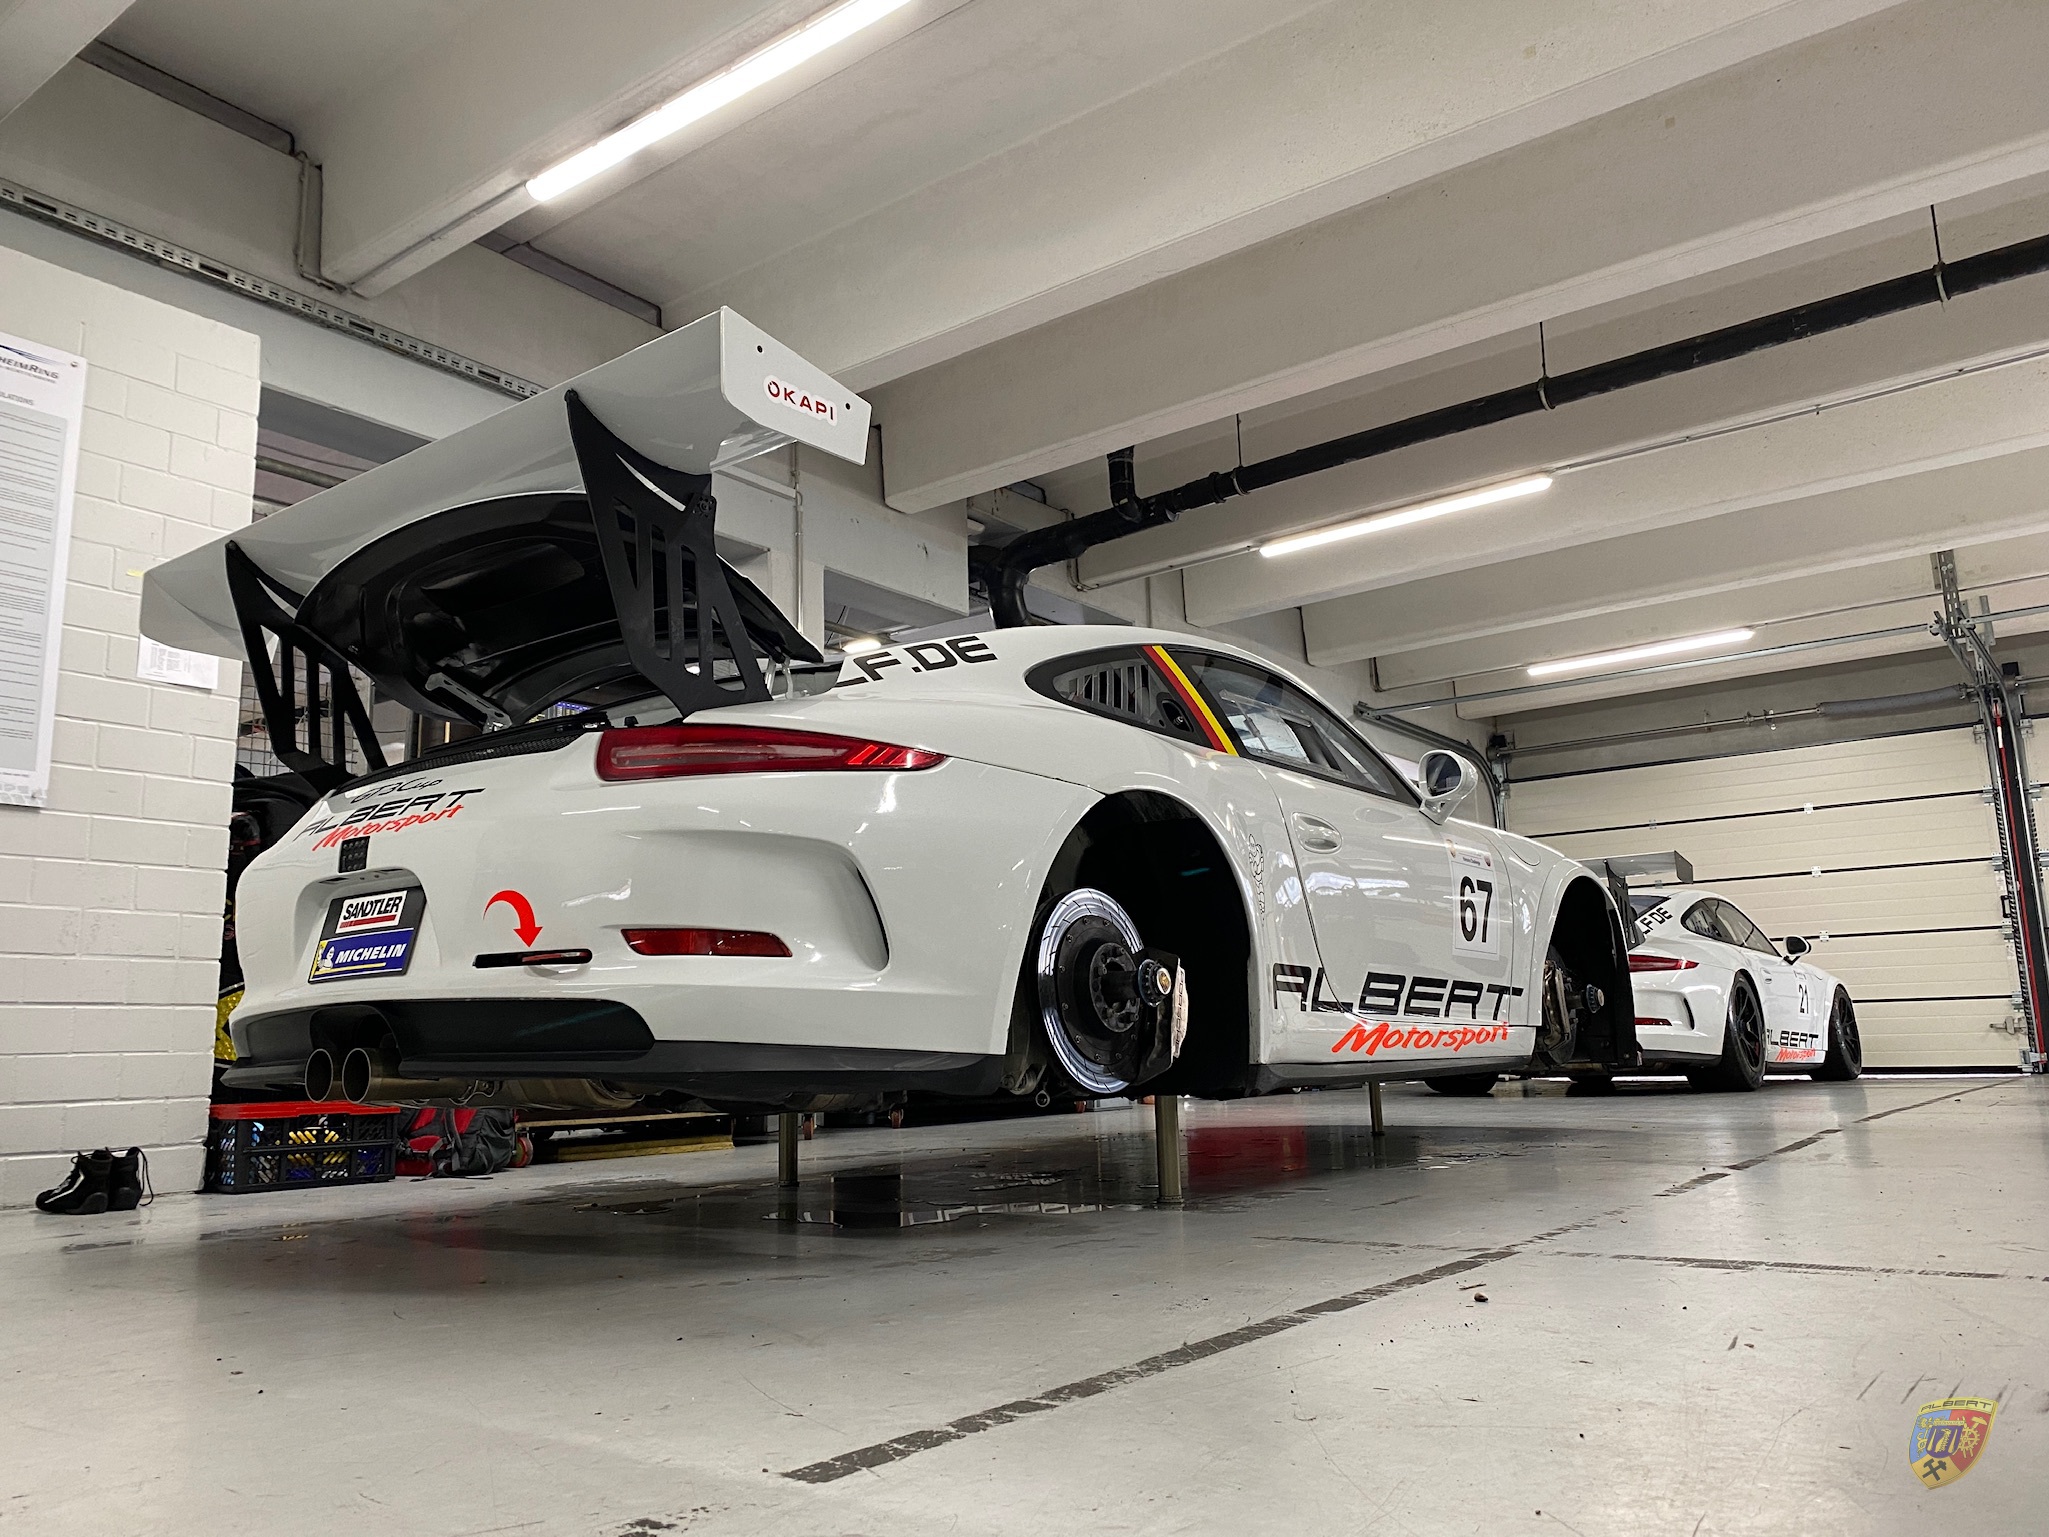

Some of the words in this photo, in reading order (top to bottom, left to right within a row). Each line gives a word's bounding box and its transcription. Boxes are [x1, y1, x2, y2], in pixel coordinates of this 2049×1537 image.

[293, 787, 486, 841] ALBERT
[312, 804, 464, 851] Motorsport
[343, 896, 403, 920] SANDTLER
[1459, 875, 1493, 943] 67
[335, 943, 408, 965] MICHELIN
[1272, 962, 1525, 1021] ALBERT
[1331, 1020, 1509, 1056] Motorsport
